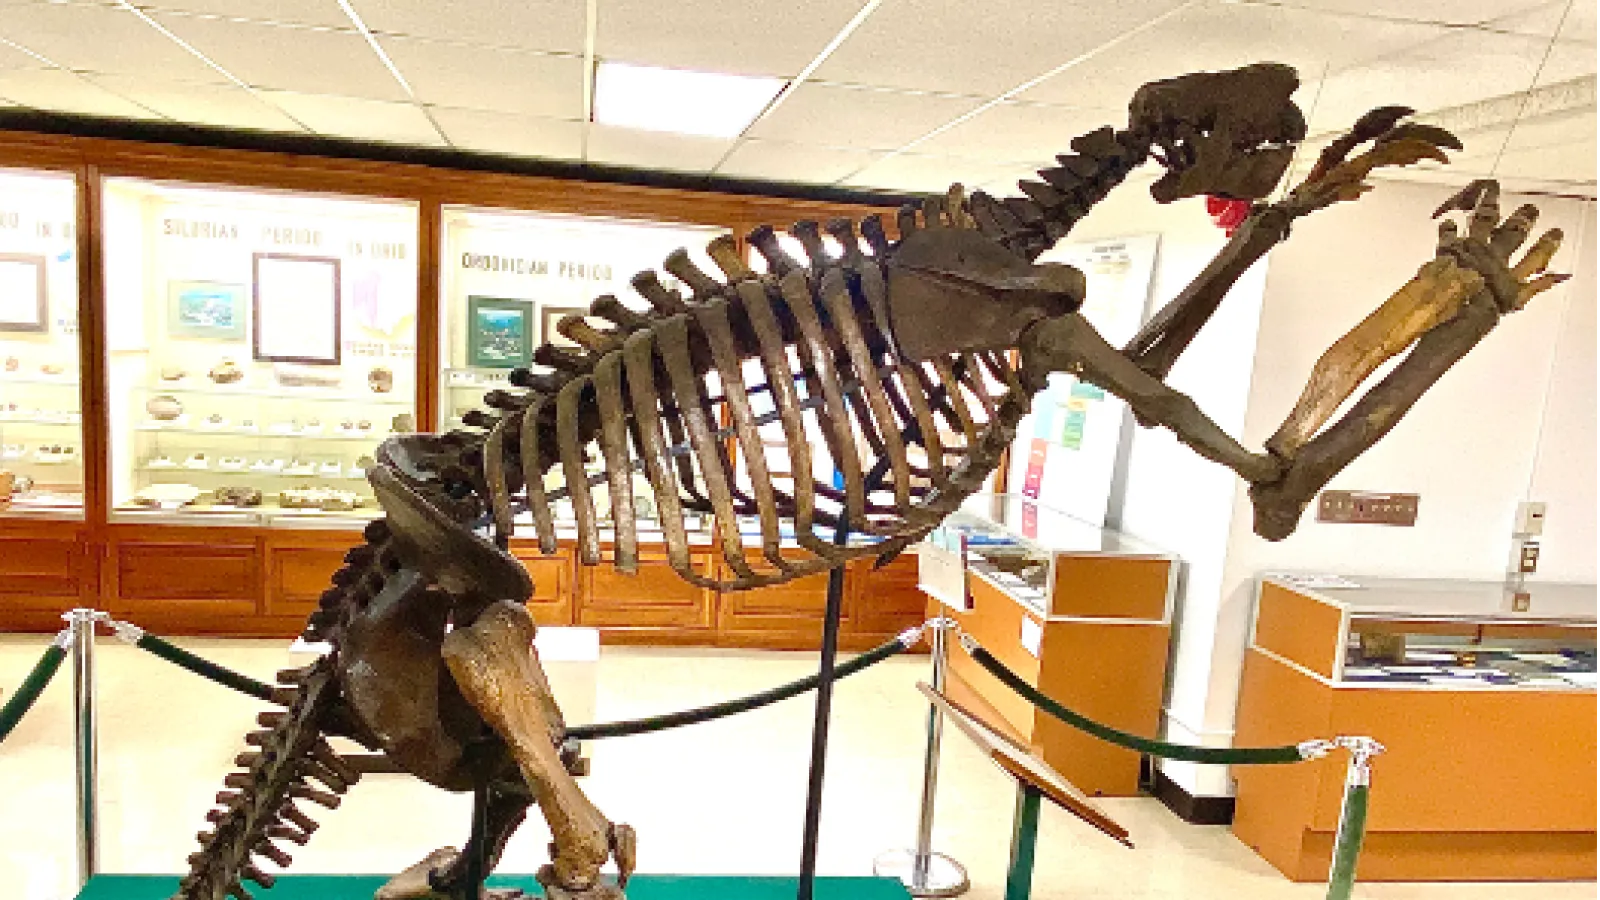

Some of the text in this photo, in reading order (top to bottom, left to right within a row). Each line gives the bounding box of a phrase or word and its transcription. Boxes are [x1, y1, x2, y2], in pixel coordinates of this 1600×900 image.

[163, 218, 238, 239] SILURIAN
[262, 226, 324, 247] PERIOD
[559, 260, 613, 281] PERIOD
